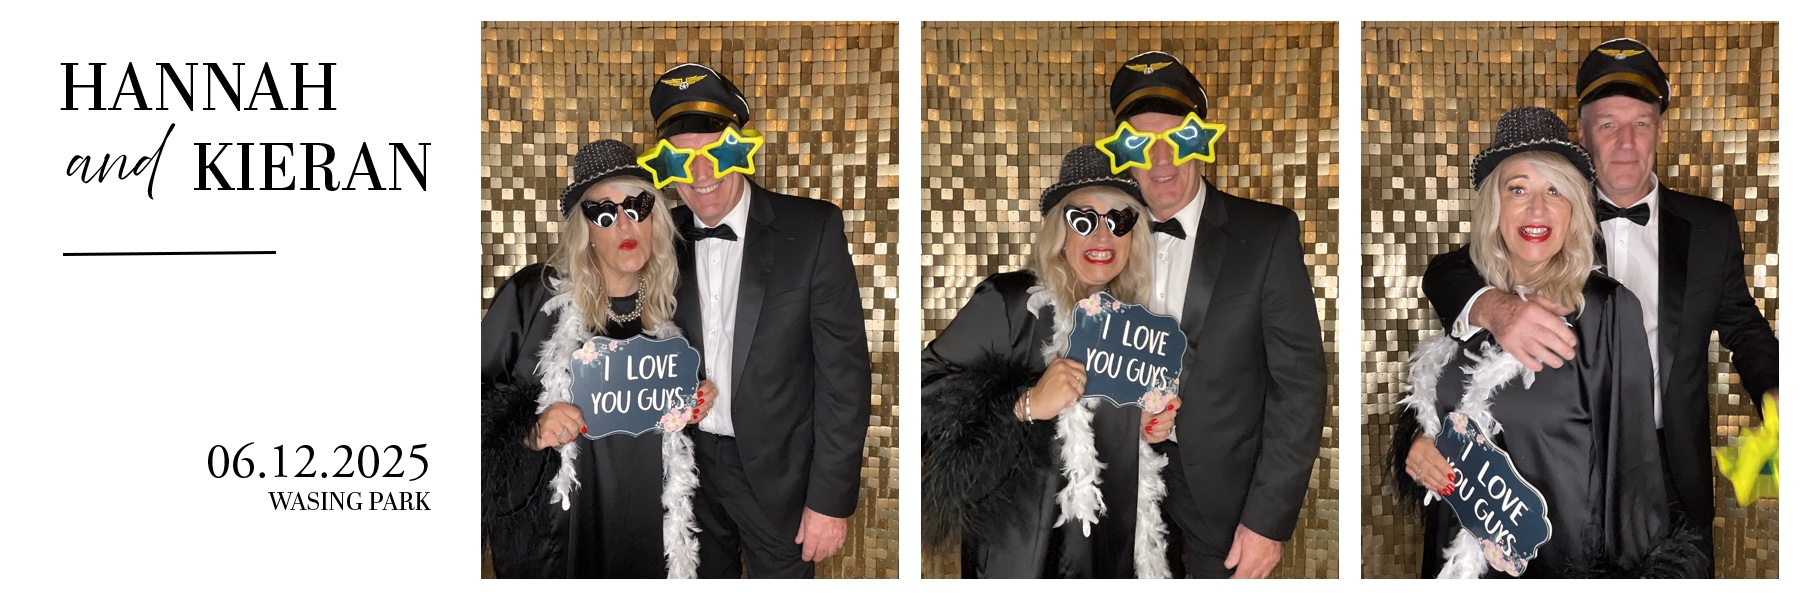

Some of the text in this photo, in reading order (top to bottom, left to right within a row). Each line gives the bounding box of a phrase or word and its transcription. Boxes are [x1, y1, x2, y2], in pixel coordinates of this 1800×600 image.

[1102, 314, 1170, 357] I LOVE
[604, 354, 679, 381] I LOVE
[1086, 348, 1169, 391] YOU GUYS
[591, 387, 685, 415] YOU GUYS
[1461, 441, 1529, 526] I LOVE
[1474, 498, 1517, 557] GUYS
